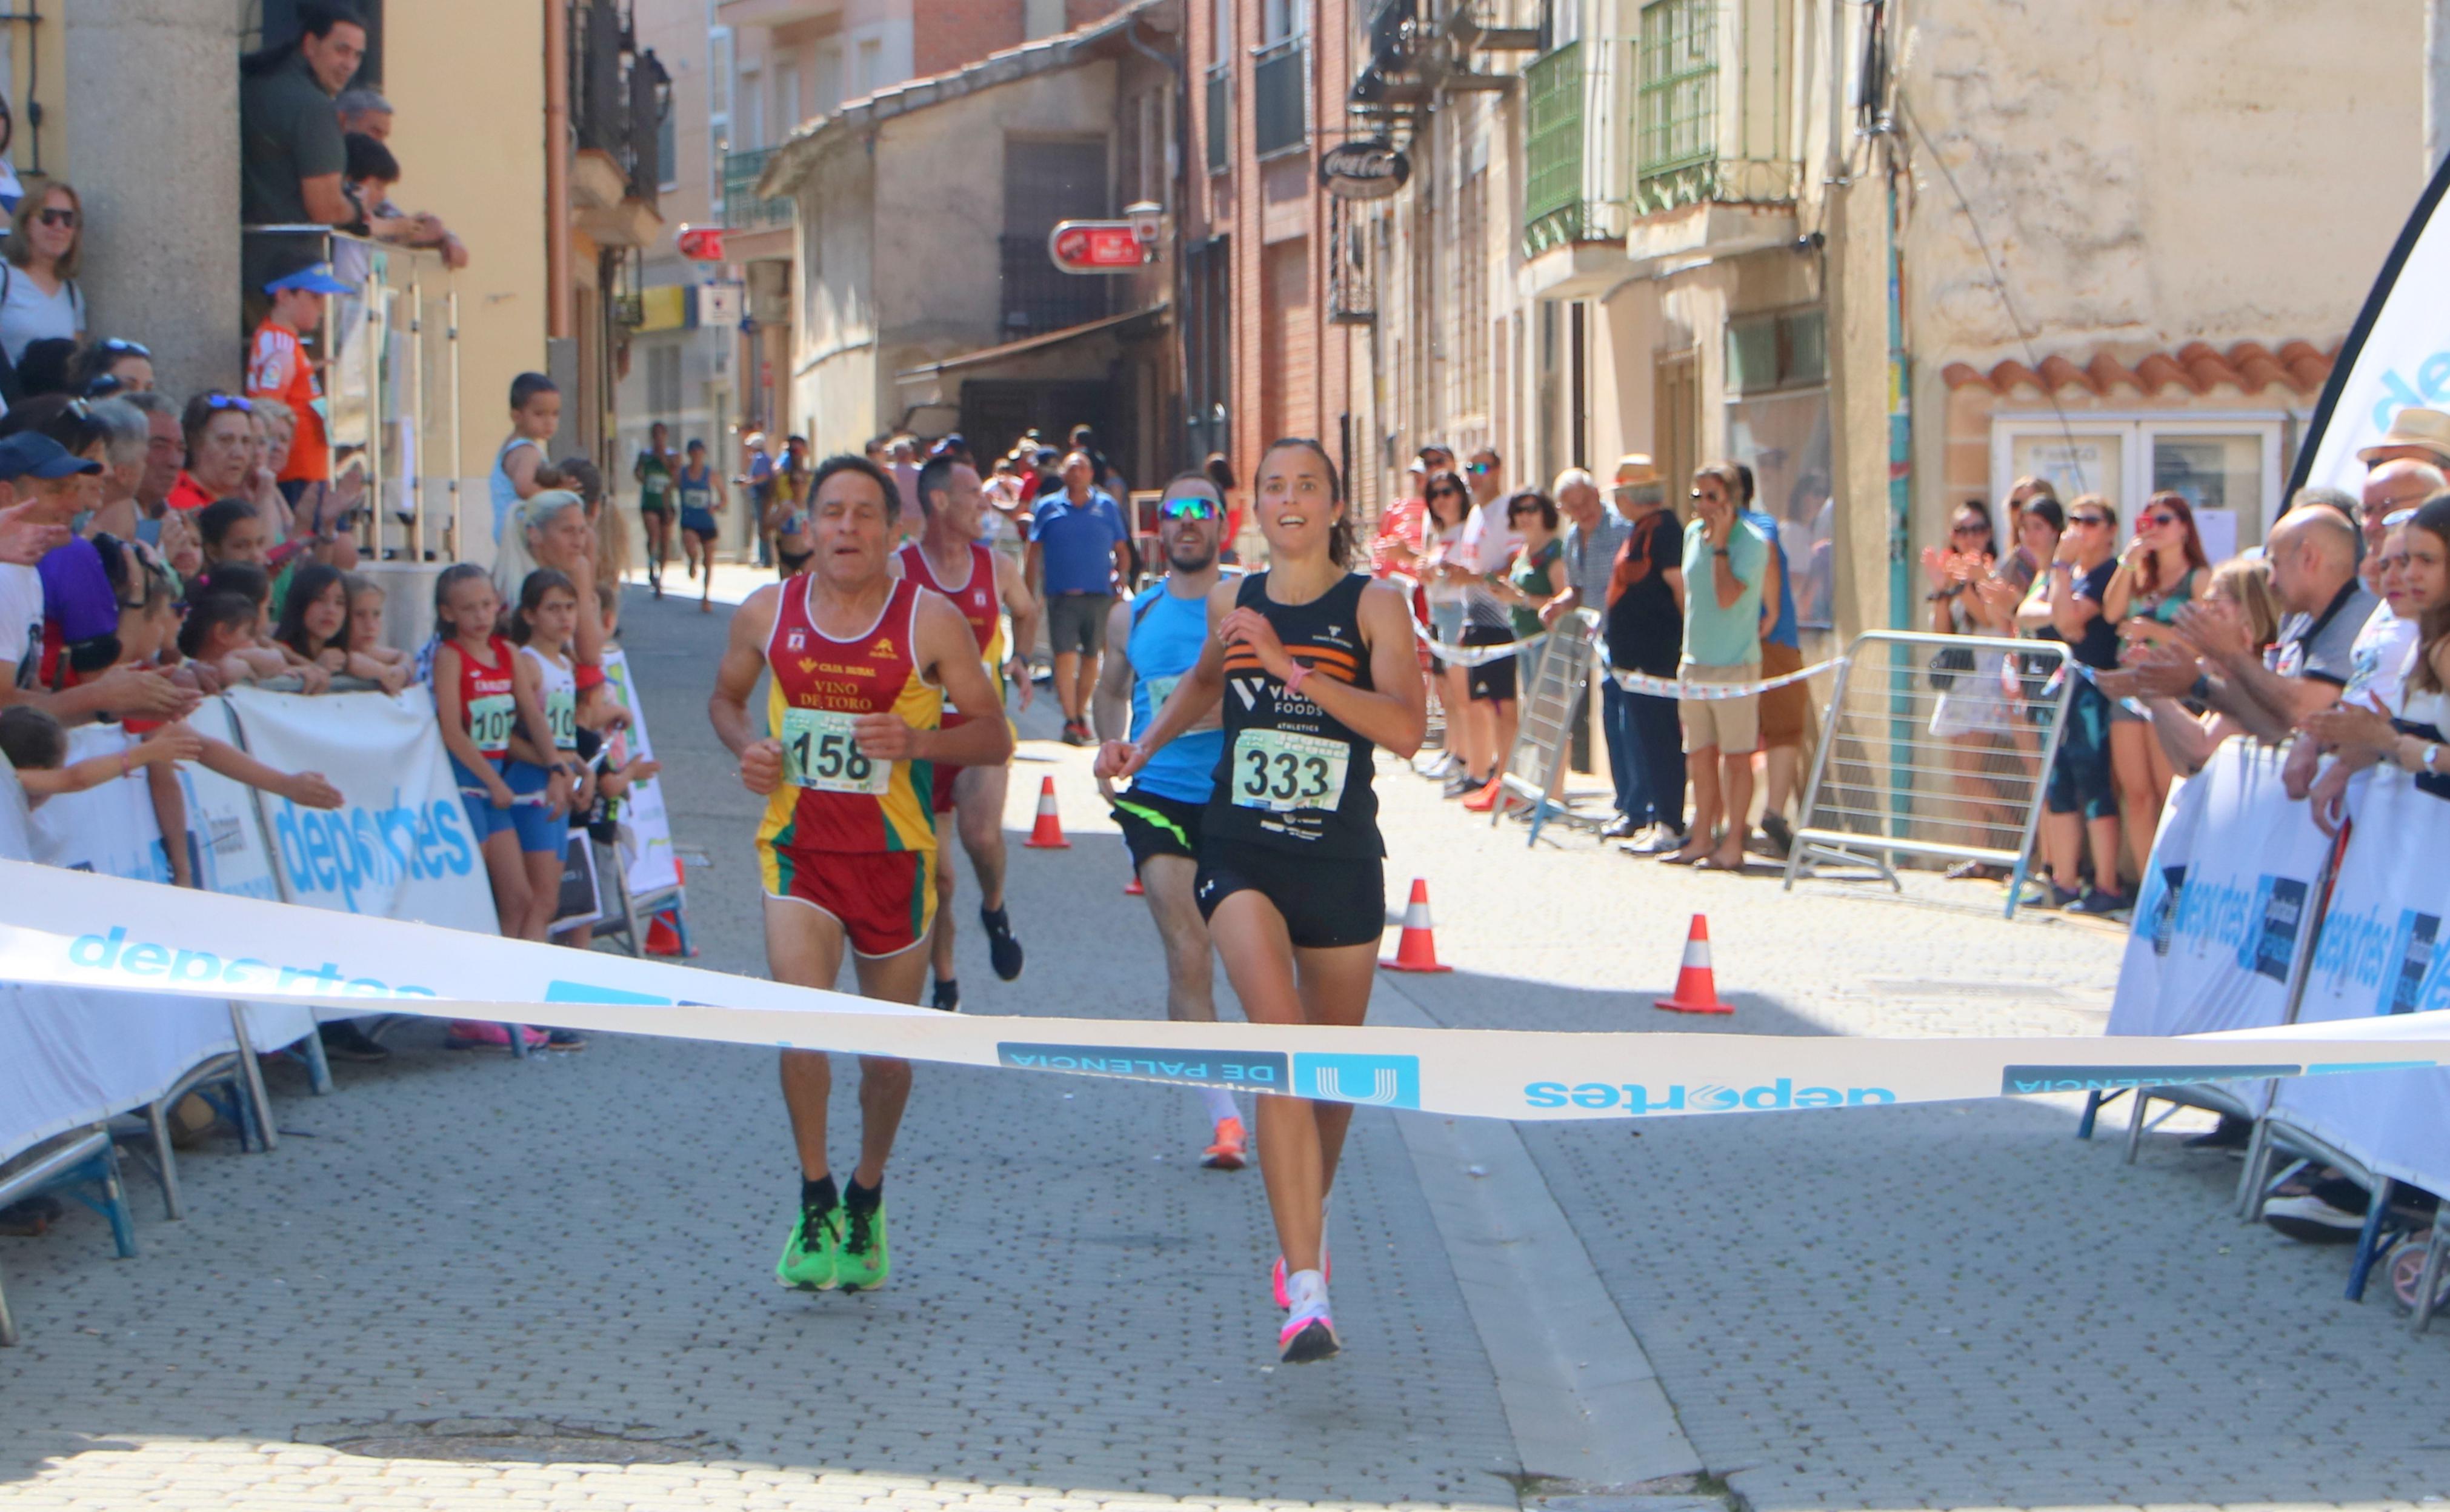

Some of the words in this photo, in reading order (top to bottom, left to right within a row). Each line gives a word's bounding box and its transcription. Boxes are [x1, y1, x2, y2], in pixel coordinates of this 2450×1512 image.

[814, 680, 859, 696] VINO
[800, 693, 821, 706] DE
[825, 695, 873, 710] TORO
[1274, 702, 1323, 716] FOODS
[1277, 723, 1319, 732] ATHLETICS
[793, 731, 871, 780] 158
[1244, 750, 1328, 799] 333
[1010, 1053, 1208, 1078] PALENCIA
[1222, 1064, 1275, 1082] DE
